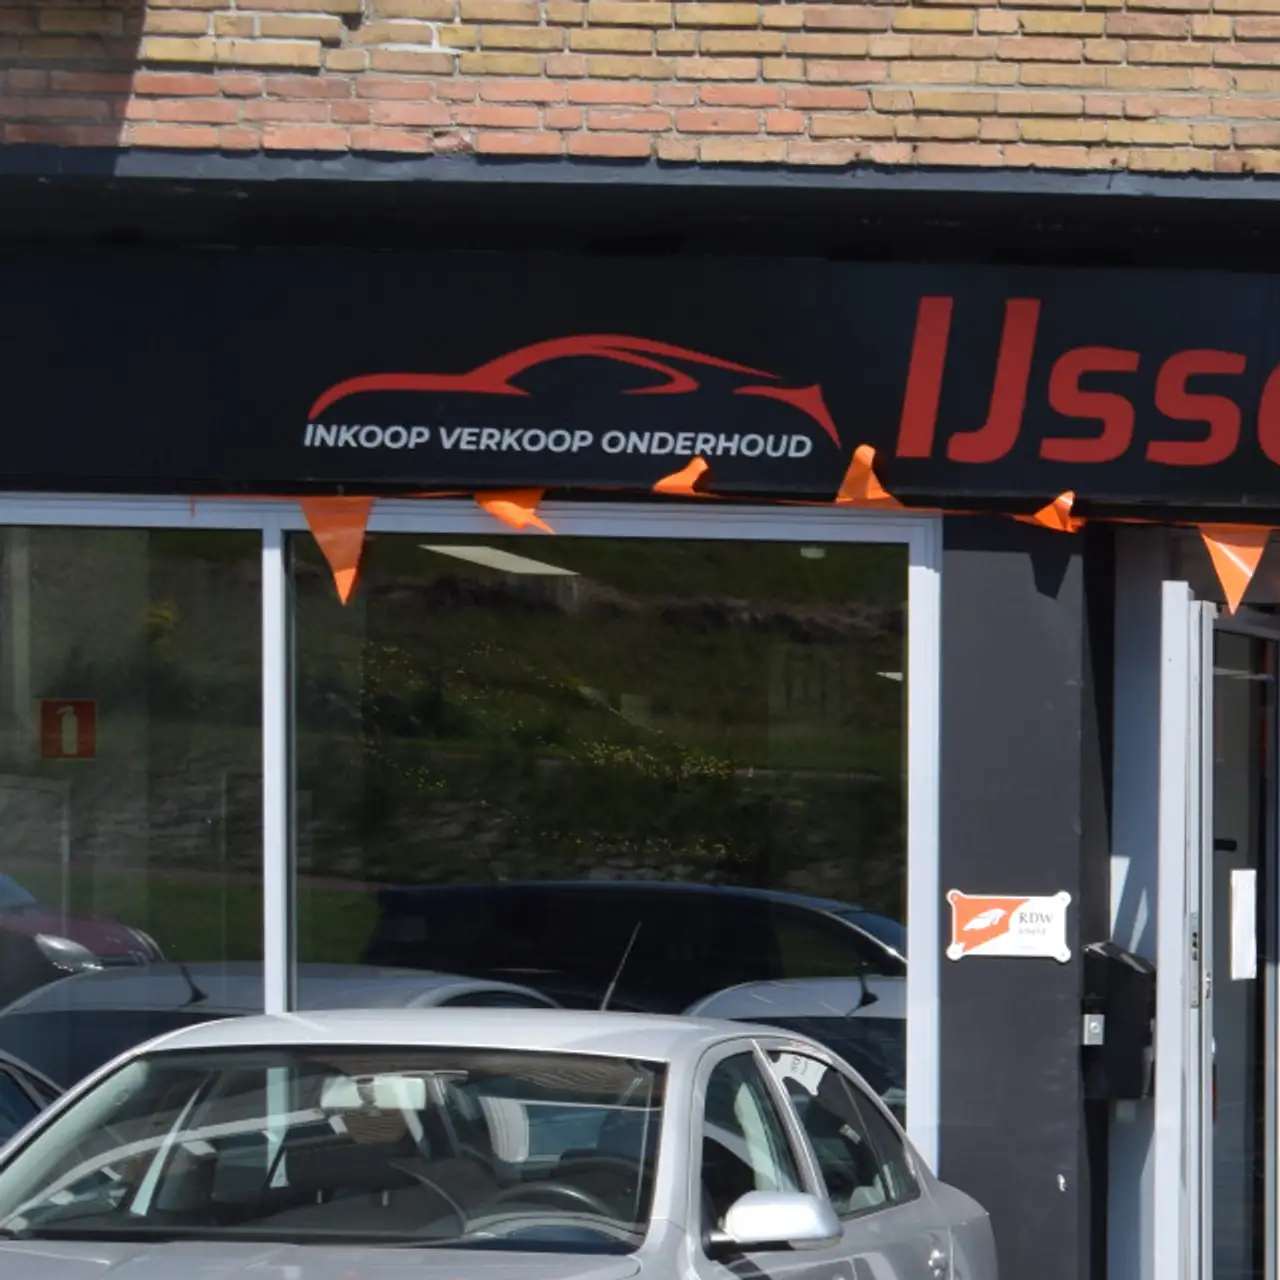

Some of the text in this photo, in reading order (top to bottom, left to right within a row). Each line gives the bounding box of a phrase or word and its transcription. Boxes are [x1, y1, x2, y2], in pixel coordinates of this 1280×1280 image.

[304, 423, 813, 458] INKOOP VERKOOP ONDERHOUD
[1019, 911, 1053, 924] RDW
